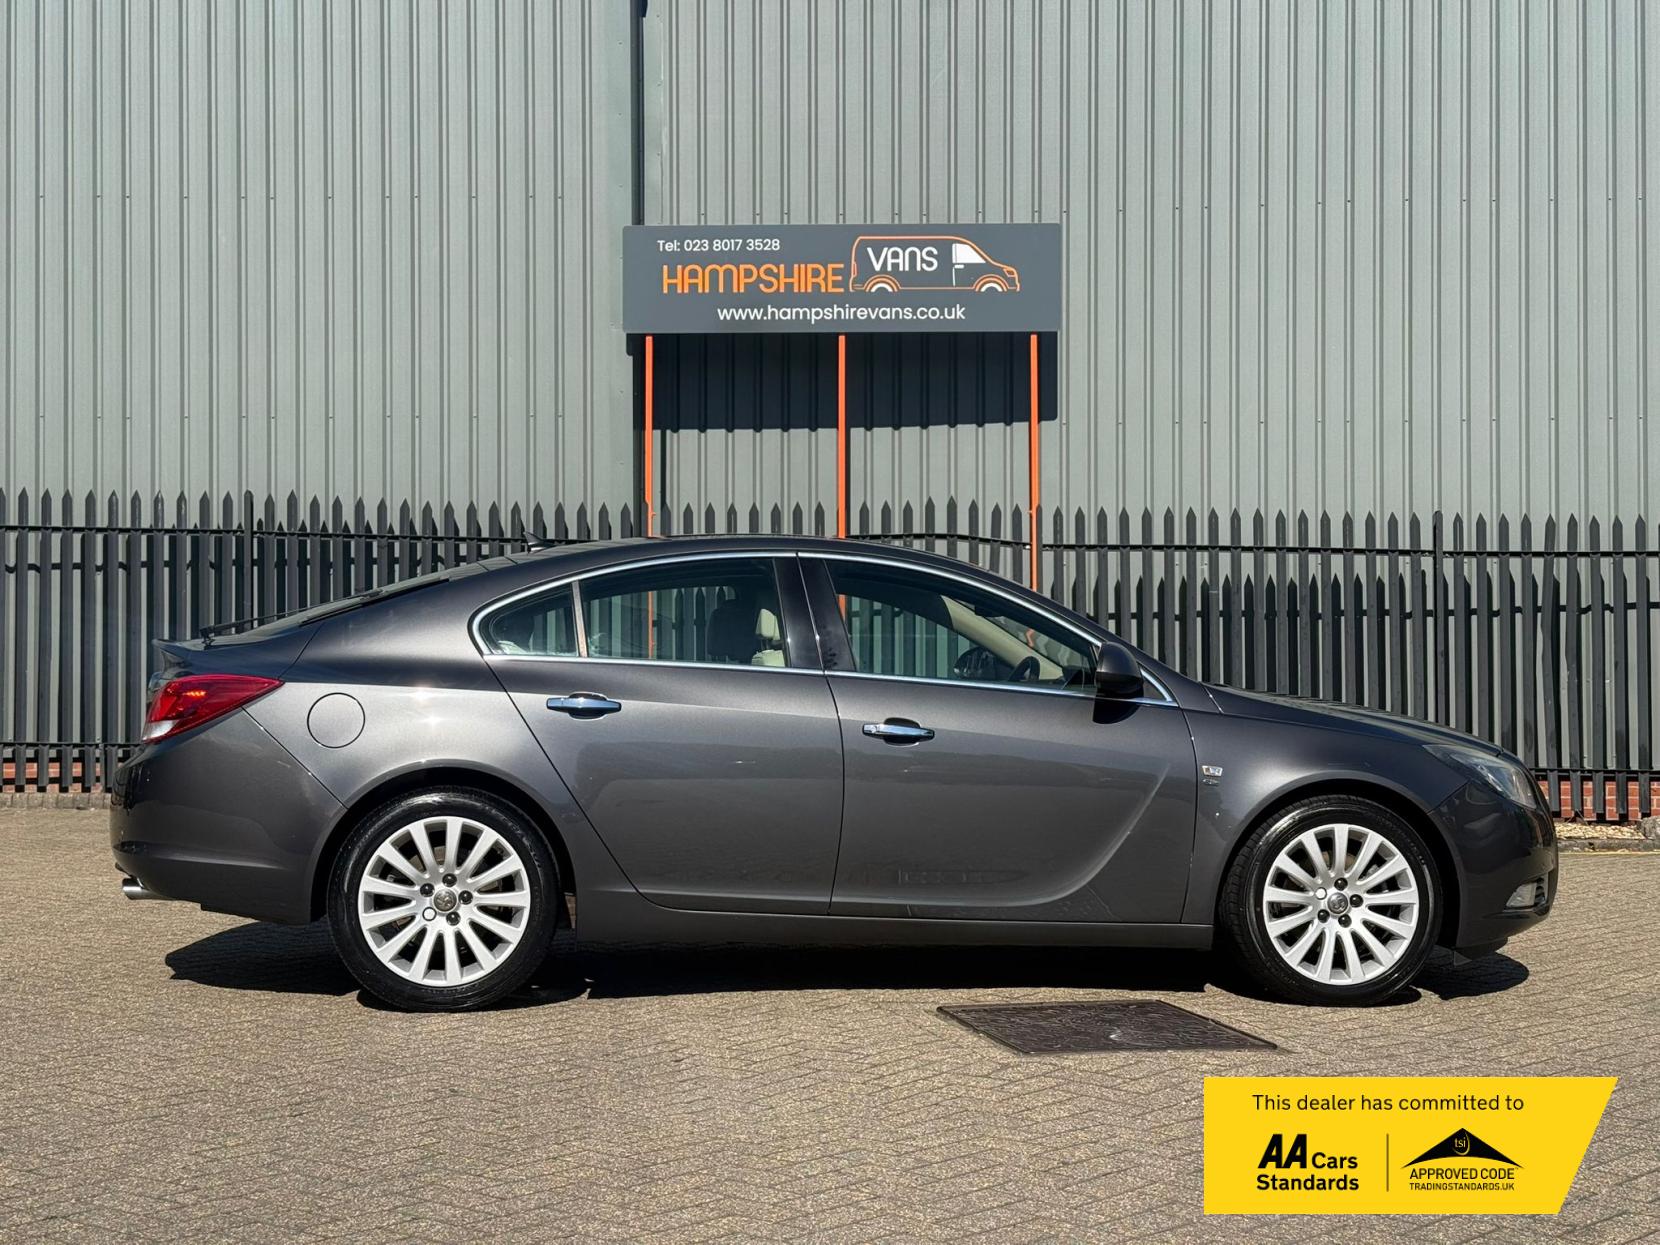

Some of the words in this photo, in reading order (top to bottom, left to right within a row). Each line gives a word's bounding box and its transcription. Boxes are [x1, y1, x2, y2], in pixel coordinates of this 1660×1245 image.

[657, 239, 681, 252] Tel:
[683, 239, 709, 252] 023
[712, 239, 742, 252] 8017
[745, 238, 781, 251] 3528
[662, 263, 845, 294] HAMPSHIRE
[866, 246, 939, 272] VANS
[717, 303, 966, 325] www.hampshirevans.co.uk
